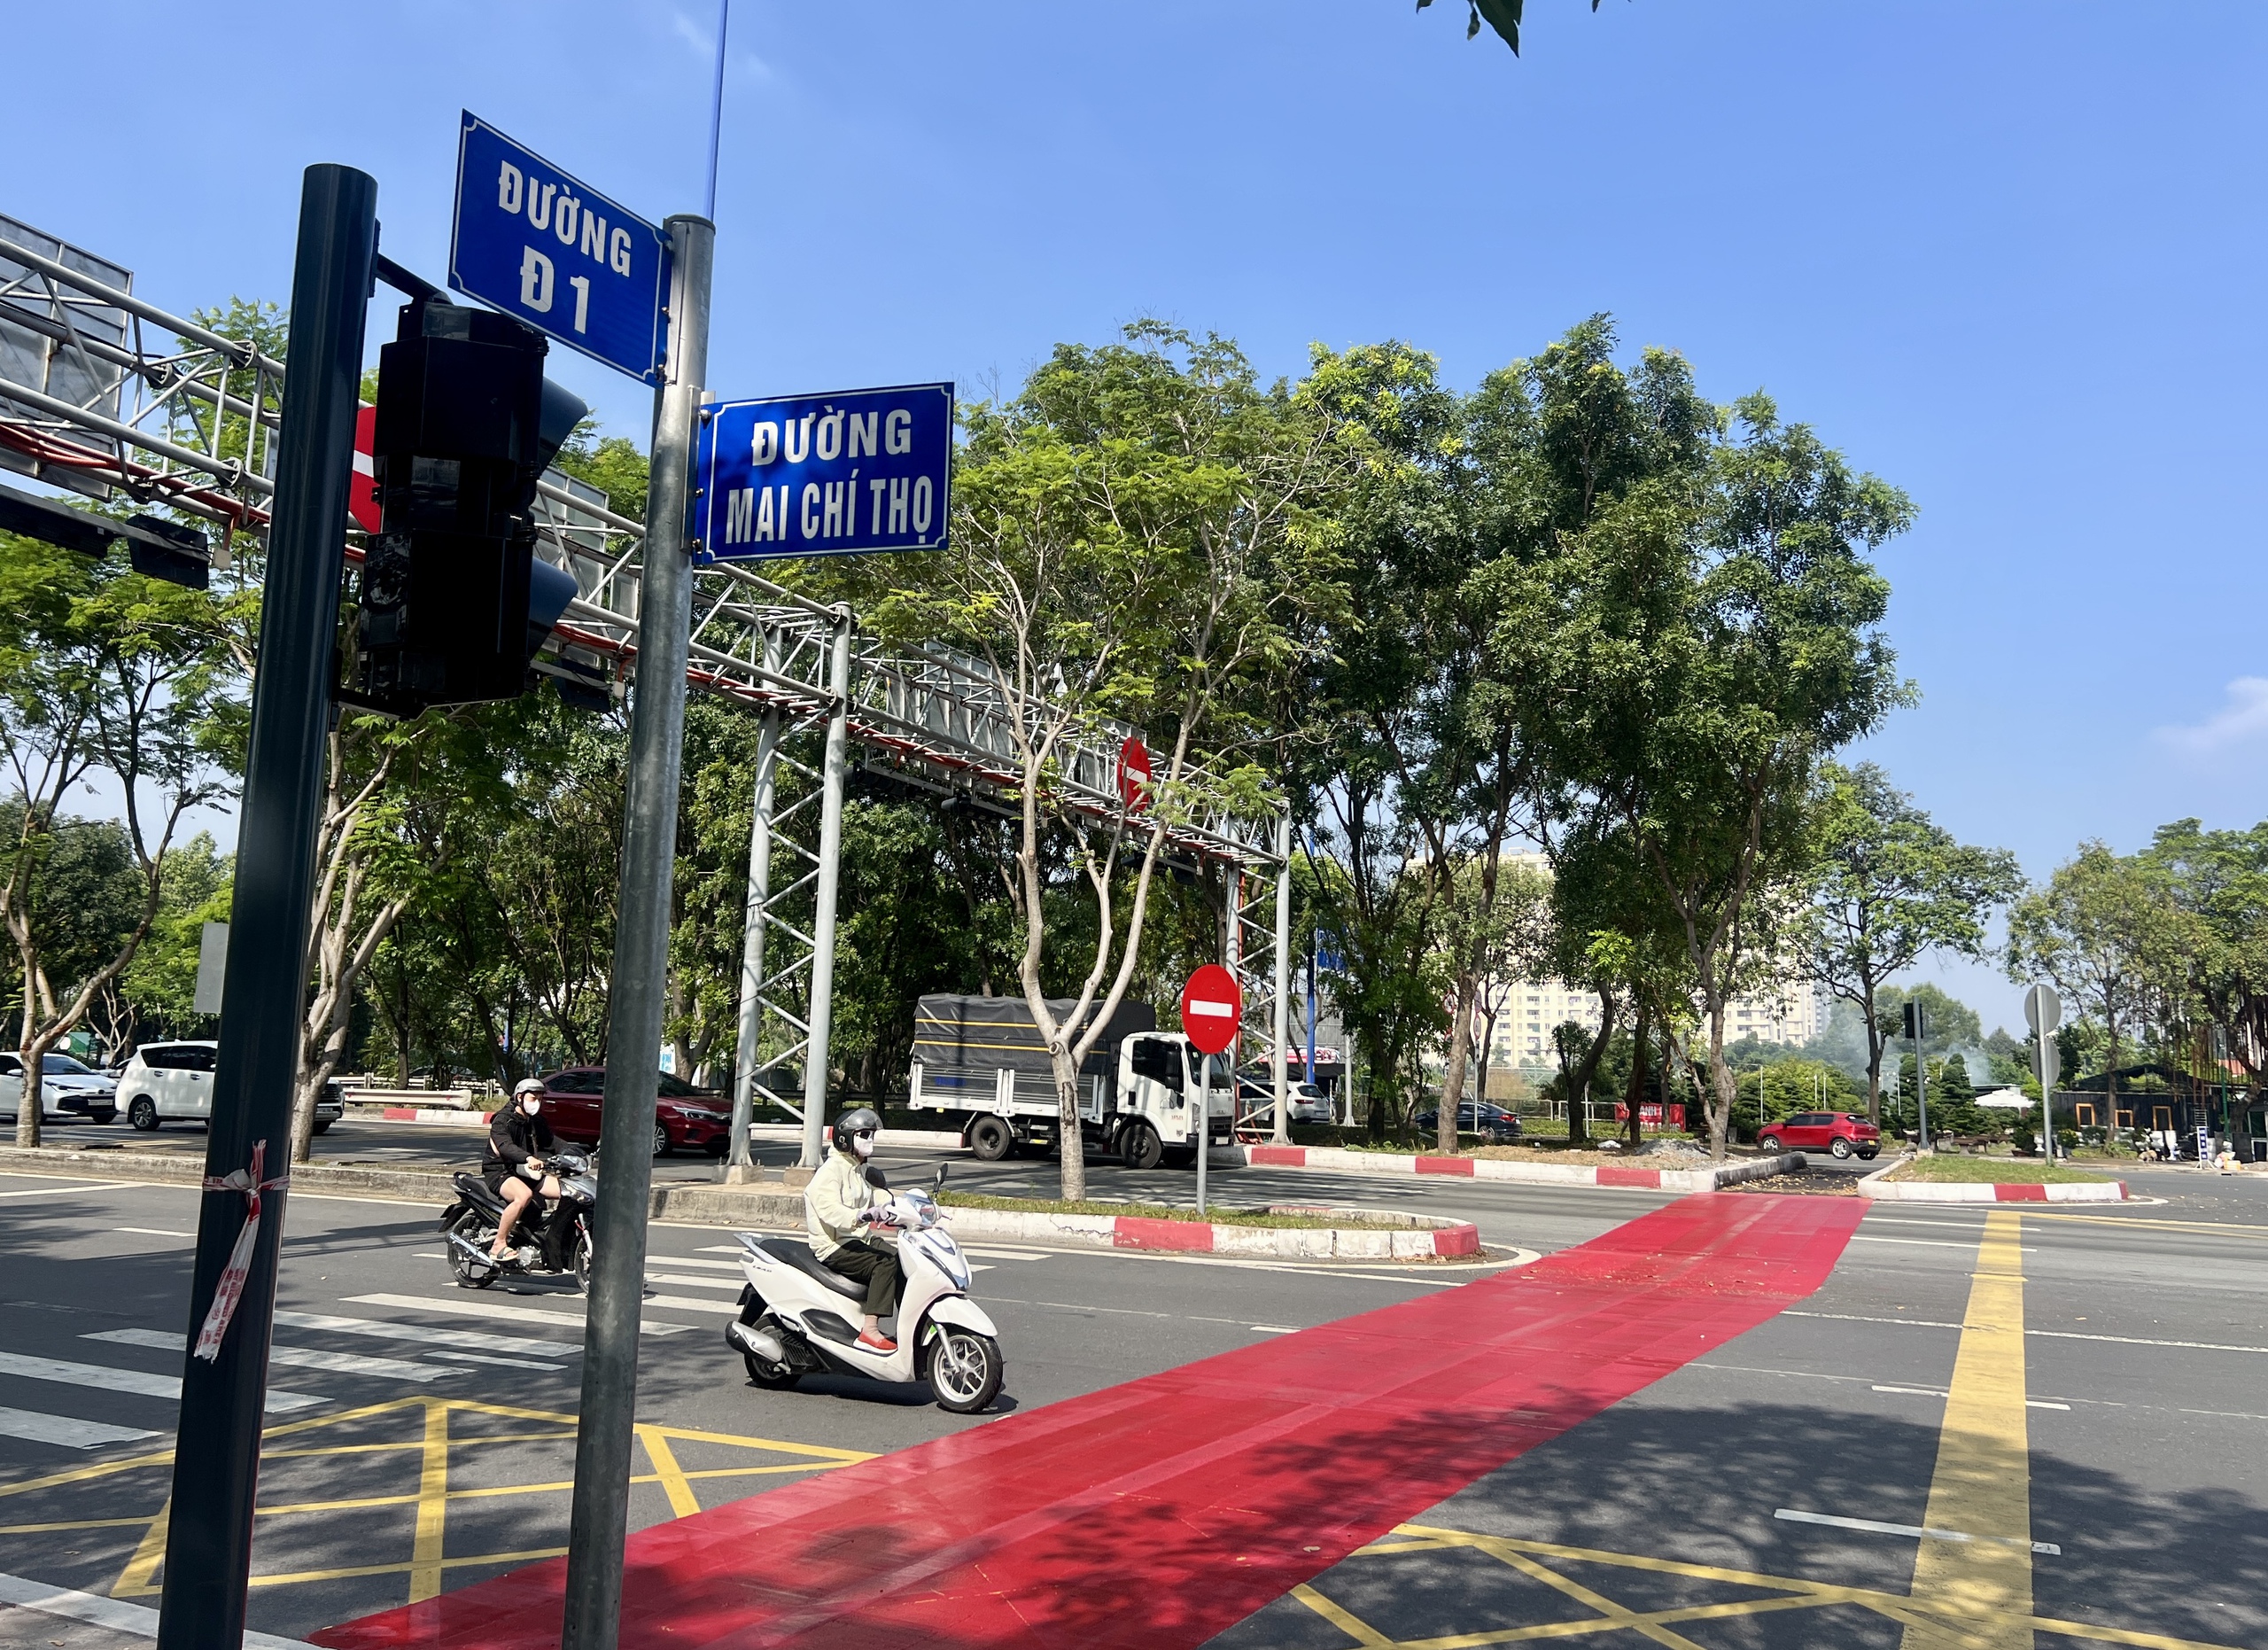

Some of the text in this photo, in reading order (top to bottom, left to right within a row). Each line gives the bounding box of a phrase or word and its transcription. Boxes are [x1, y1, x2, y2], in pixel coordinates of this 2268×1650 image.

[498, 160, 632, 278] ĐƯỜNG
[519, 245, 590, 335] Đ 1
[750, 405, 912, 466] ĐƯỜNG
[725, 468, 933, 545] MAI CHÍ THỌ
